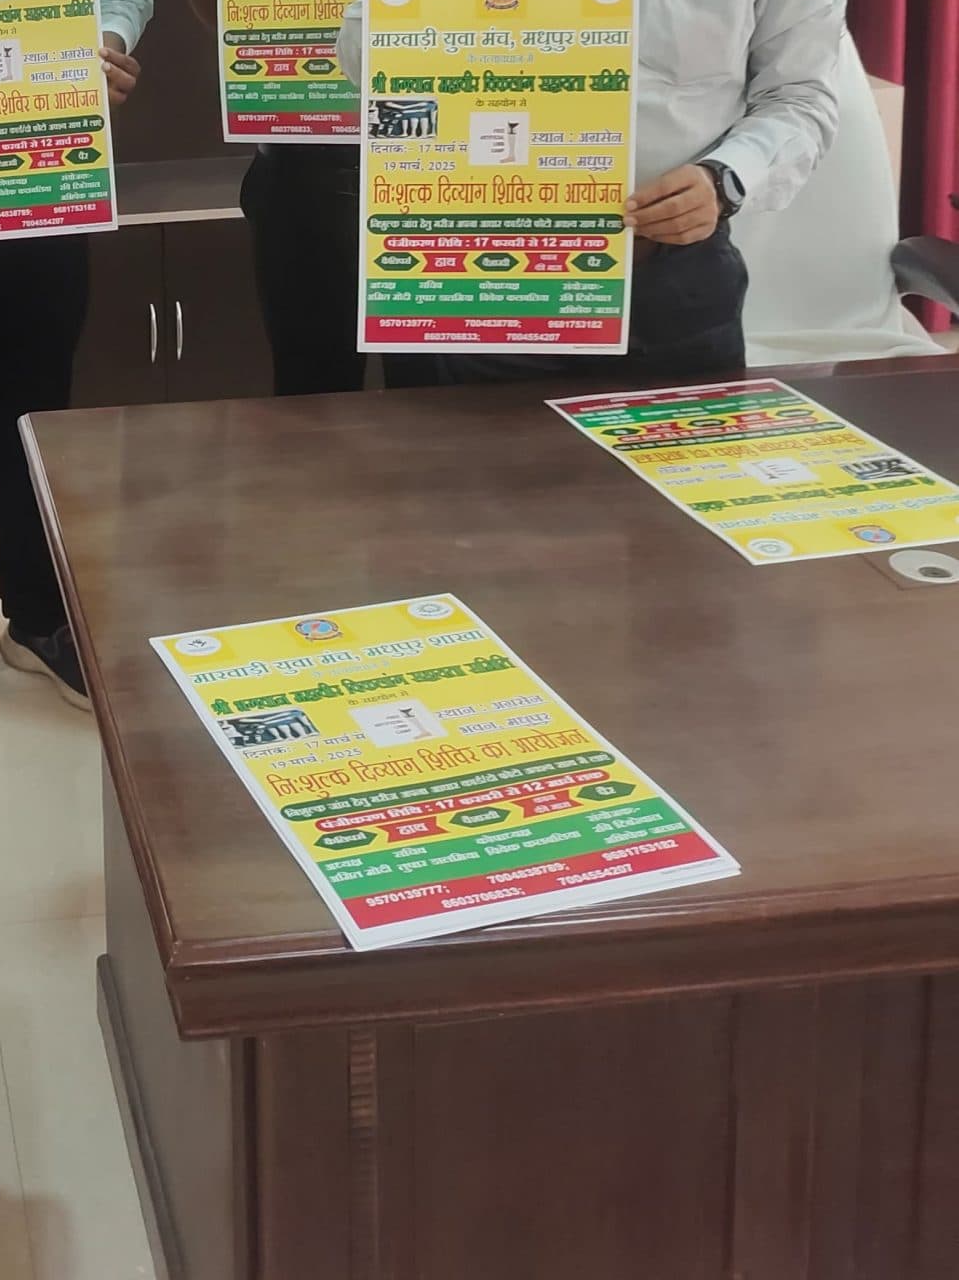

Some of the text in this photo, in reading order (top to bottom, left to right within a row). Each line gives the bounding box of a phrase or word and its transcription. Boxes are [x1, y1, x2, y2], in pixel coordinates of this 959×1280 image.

[371, 27, 630, 53] मारवाड़ी युवा मंच, मधुपुर शाखा
[384, 158, 456, 172] 19 मार्च, 2025
[437, 174, 488, 205] दिव्यांग
[491, 174, 534, 205] शिविर
[537, 182, 560, 204] का
[564, 173, 623, 204] आयोजन
[189, 663, 270, 686] मारवाड़ी
[274, 658, 314, 676] युवा
[362, 640, 423, 658] मधुपुर
[426, 631, 483, 648] शाखा
